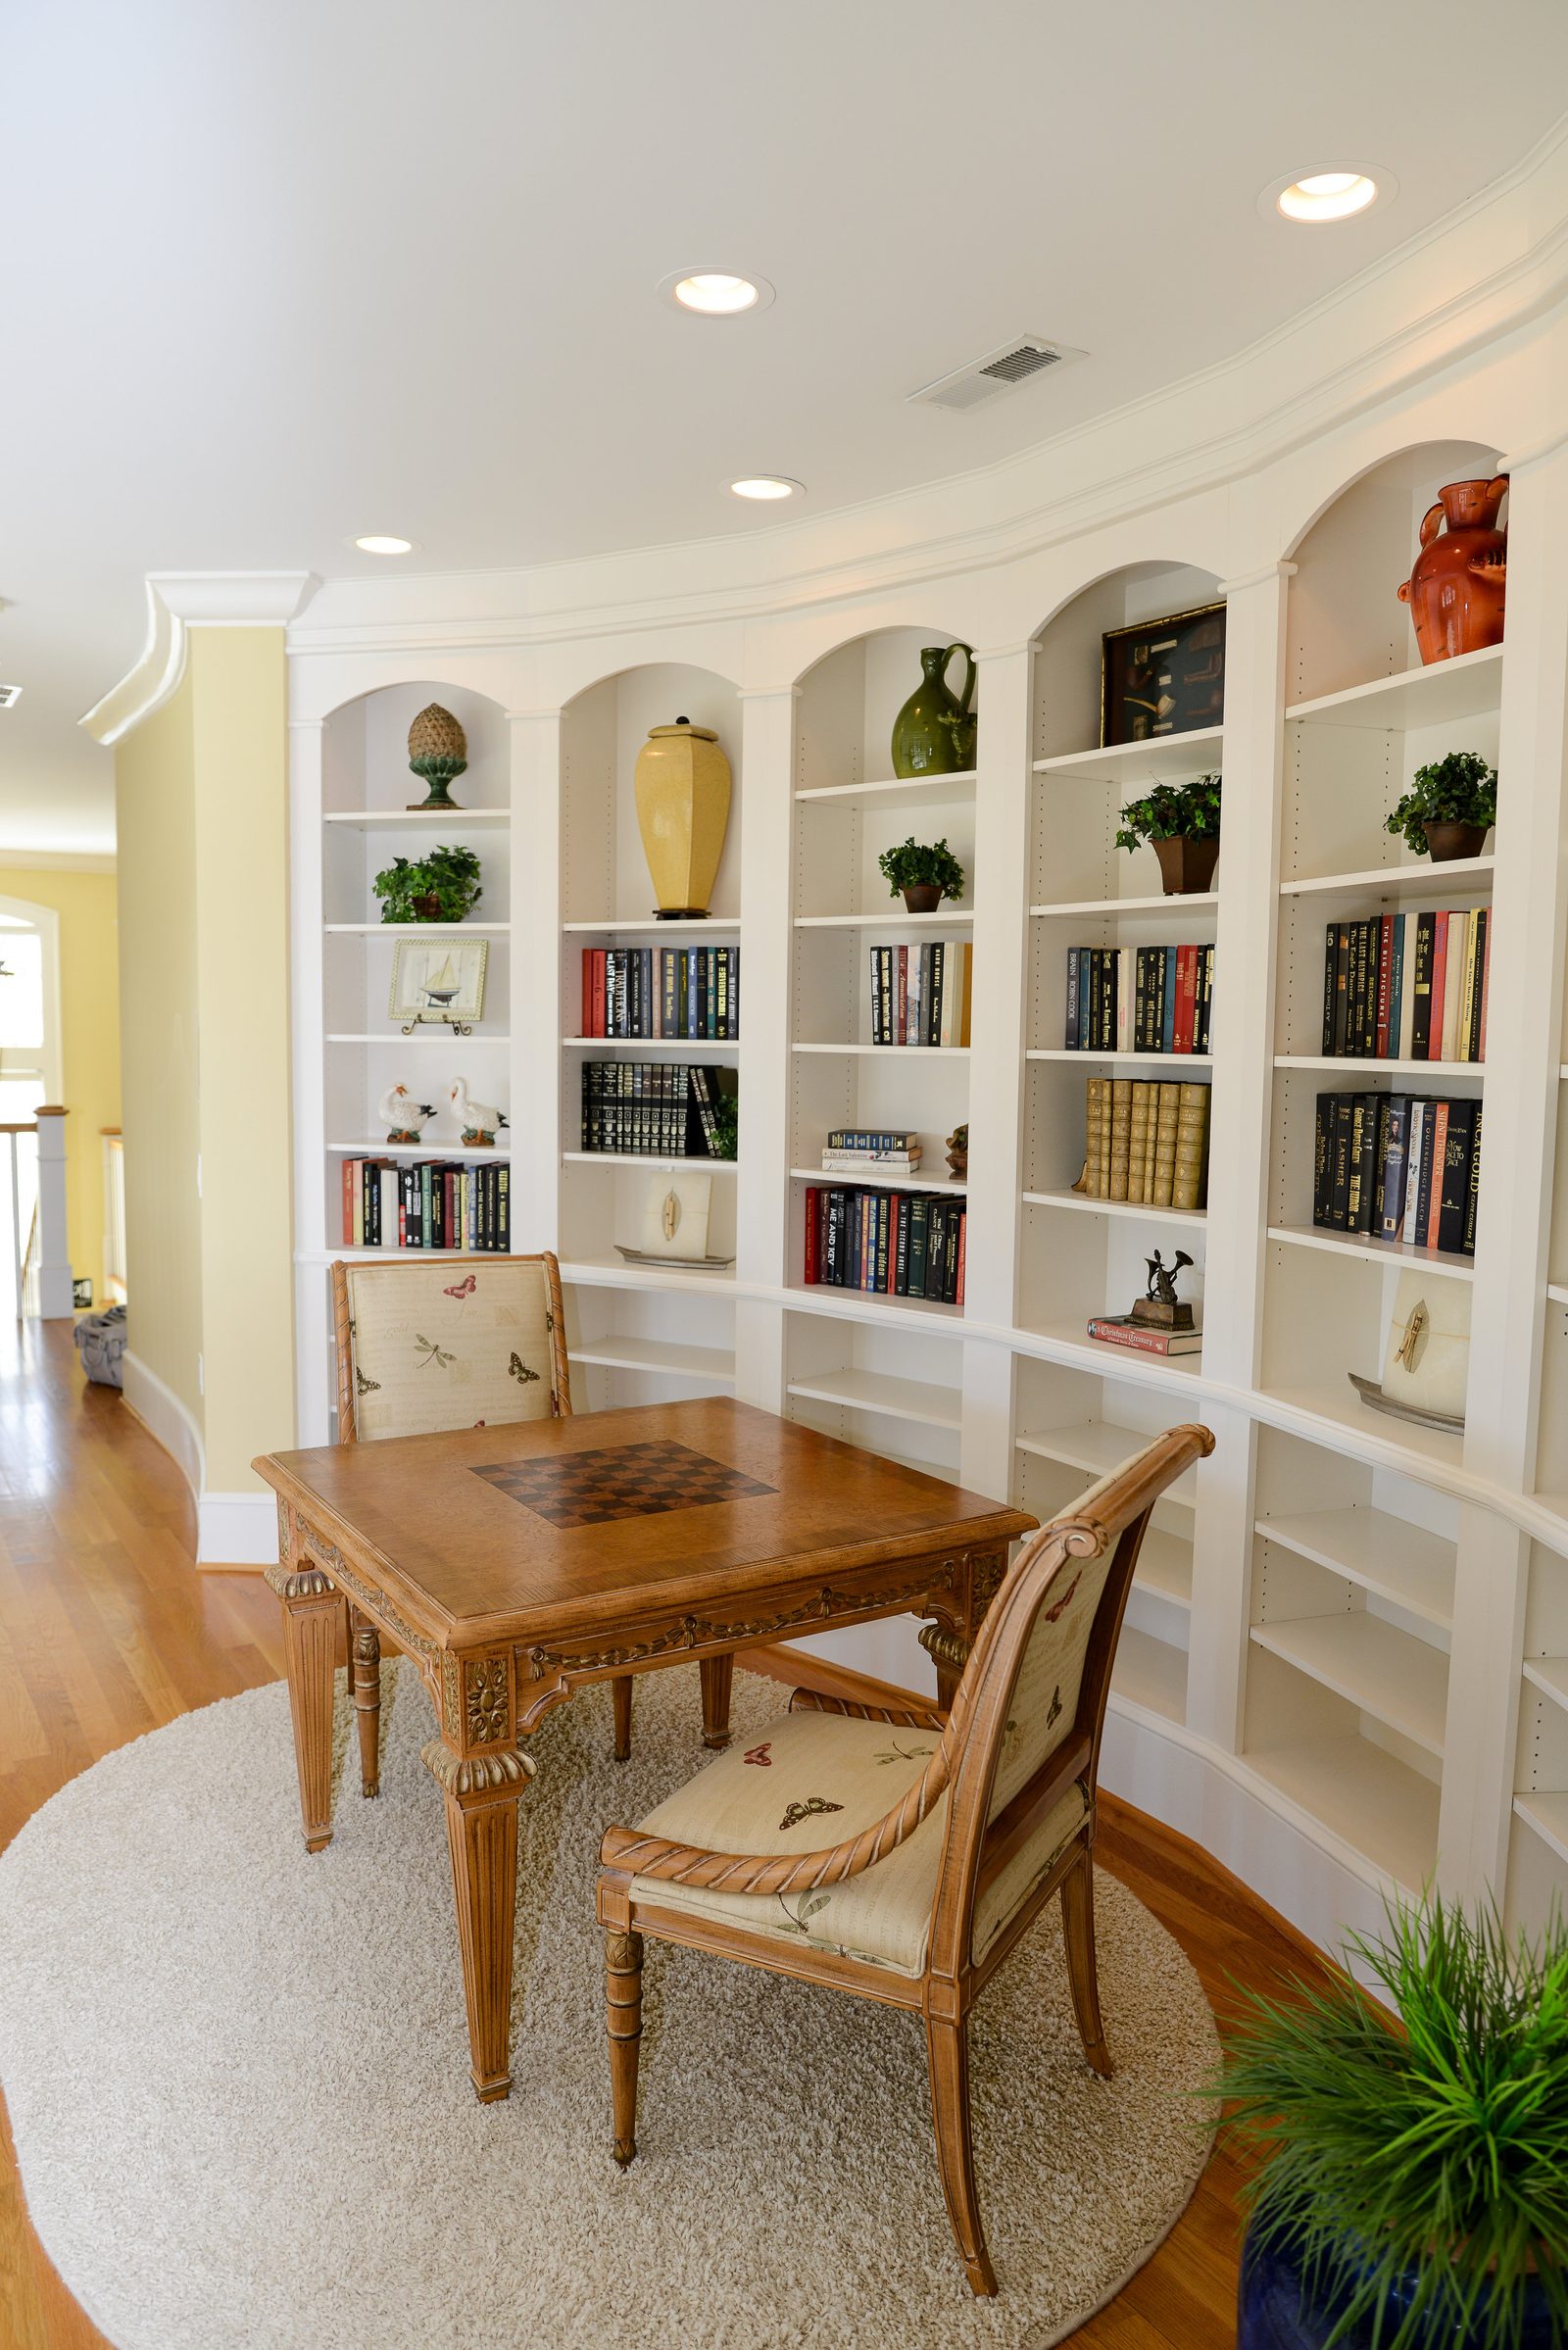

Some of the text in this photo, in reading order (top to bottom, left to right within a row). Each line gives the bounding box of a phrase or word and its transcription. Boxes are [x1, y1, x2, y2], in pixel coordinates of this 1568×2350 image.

[1358, 927, 1367, 939] THE
[606, 960, 615, 977] LAST
[606, 978, 615, 993] DAY
[1356, 960, 1366, 993] OLYMPICS
[615, 968, 627, 1023] TRADITIONS
[1102, 1009, 1111, 1044] Family Story
[1351, 1107, 1365, 1164] GEORGE DAWES GREEN
[1435, 1111, 1446, 1177] SILENT THUNDER
[1337, 1138, 1347, 1187] LASHER
[1421, 1127, 1431, 1189] OUTERBRIDGE
[1470, 1152, 1481, 1193] GOLD
[499, 1170, 509, 1194] VERITAS
[1348, 1174, 1361, 1213] THE JUROR
[829, 1207, 837, 1222] ME
[878, 1252, 887, 1276] gideon
[1101, 1326, 1128, 1339] Christmas
[1128, 1332, 1153, 1346] Treasury
